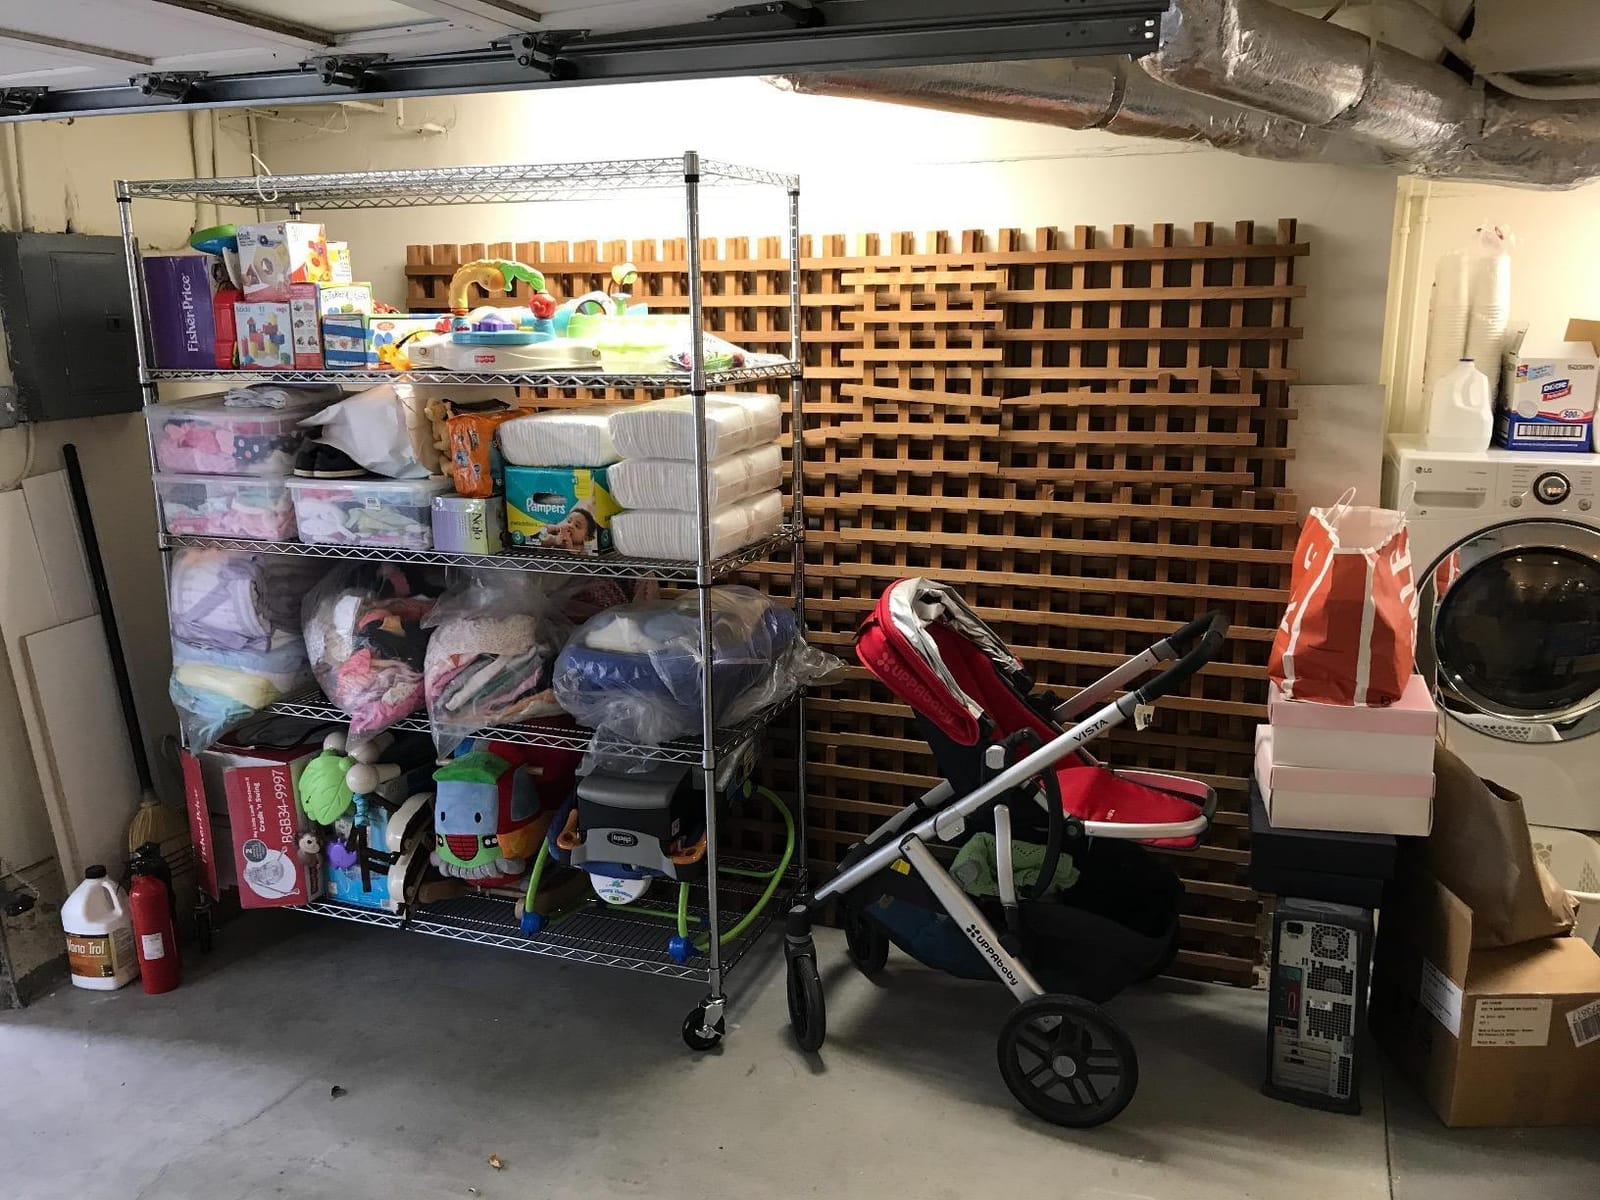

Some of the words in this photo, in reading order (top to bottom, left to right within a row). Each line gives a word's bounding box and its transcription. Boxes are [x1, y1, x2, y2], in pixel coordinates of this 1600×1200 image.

[181, 275, 199, 352] Fisher-Price
[526, 497, 566, 515] Pampers
[514, 531, 522, 541] 3
[1072, 719, 1109, 742] VISTA
[253, 782, 262, 802] Swing
[271, 769, 294, 843] BGB34-9997
[257, 811, 266, 832] Cradle
[87, 940, 105, 955] Trol
[976, 935, 1019, 986] UPPAbaby
